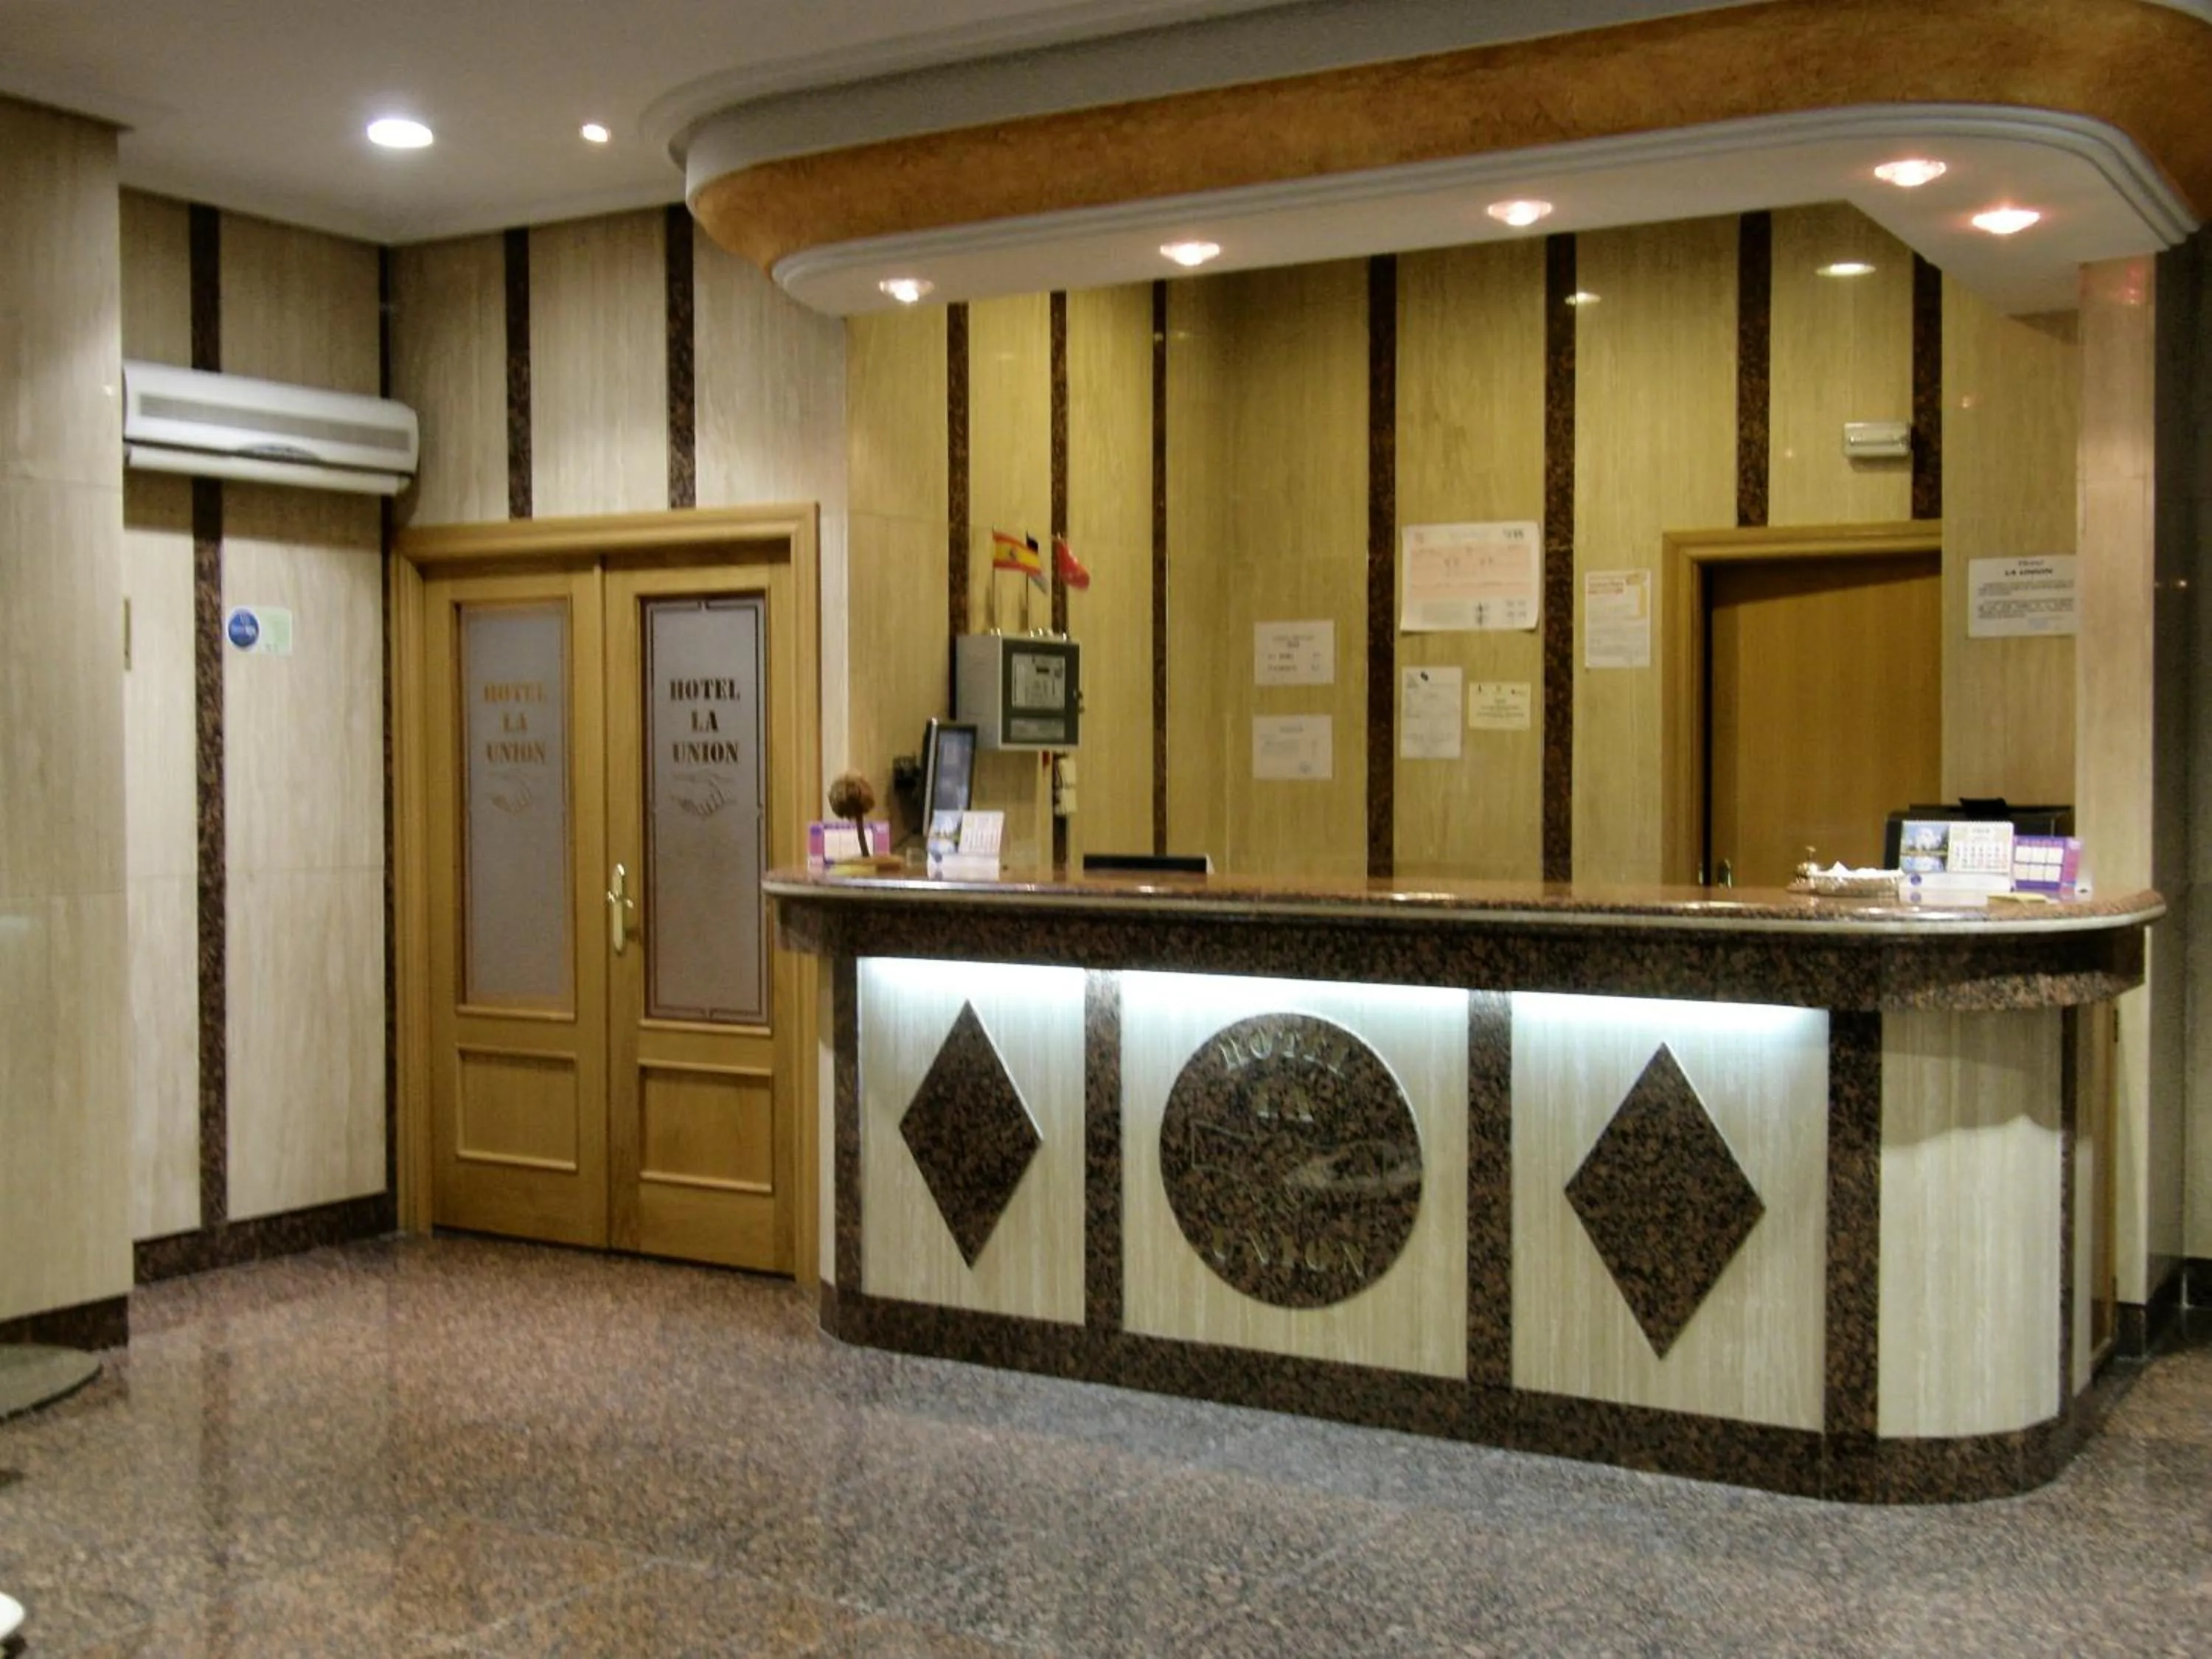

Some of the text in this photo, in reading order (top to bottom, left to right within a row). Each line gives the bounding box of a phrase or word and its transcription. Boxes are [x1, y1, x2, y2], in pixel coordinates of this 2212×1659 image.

[484, 681, 547, 703] HOTEL
[670, 678, 740, 701] HOTEL
[502, 712, 528, 733] LA
[692, 710, 719, 734] LA
[487, 740, 545, 764] UNION
[672, 740, 738, 764] UNION
